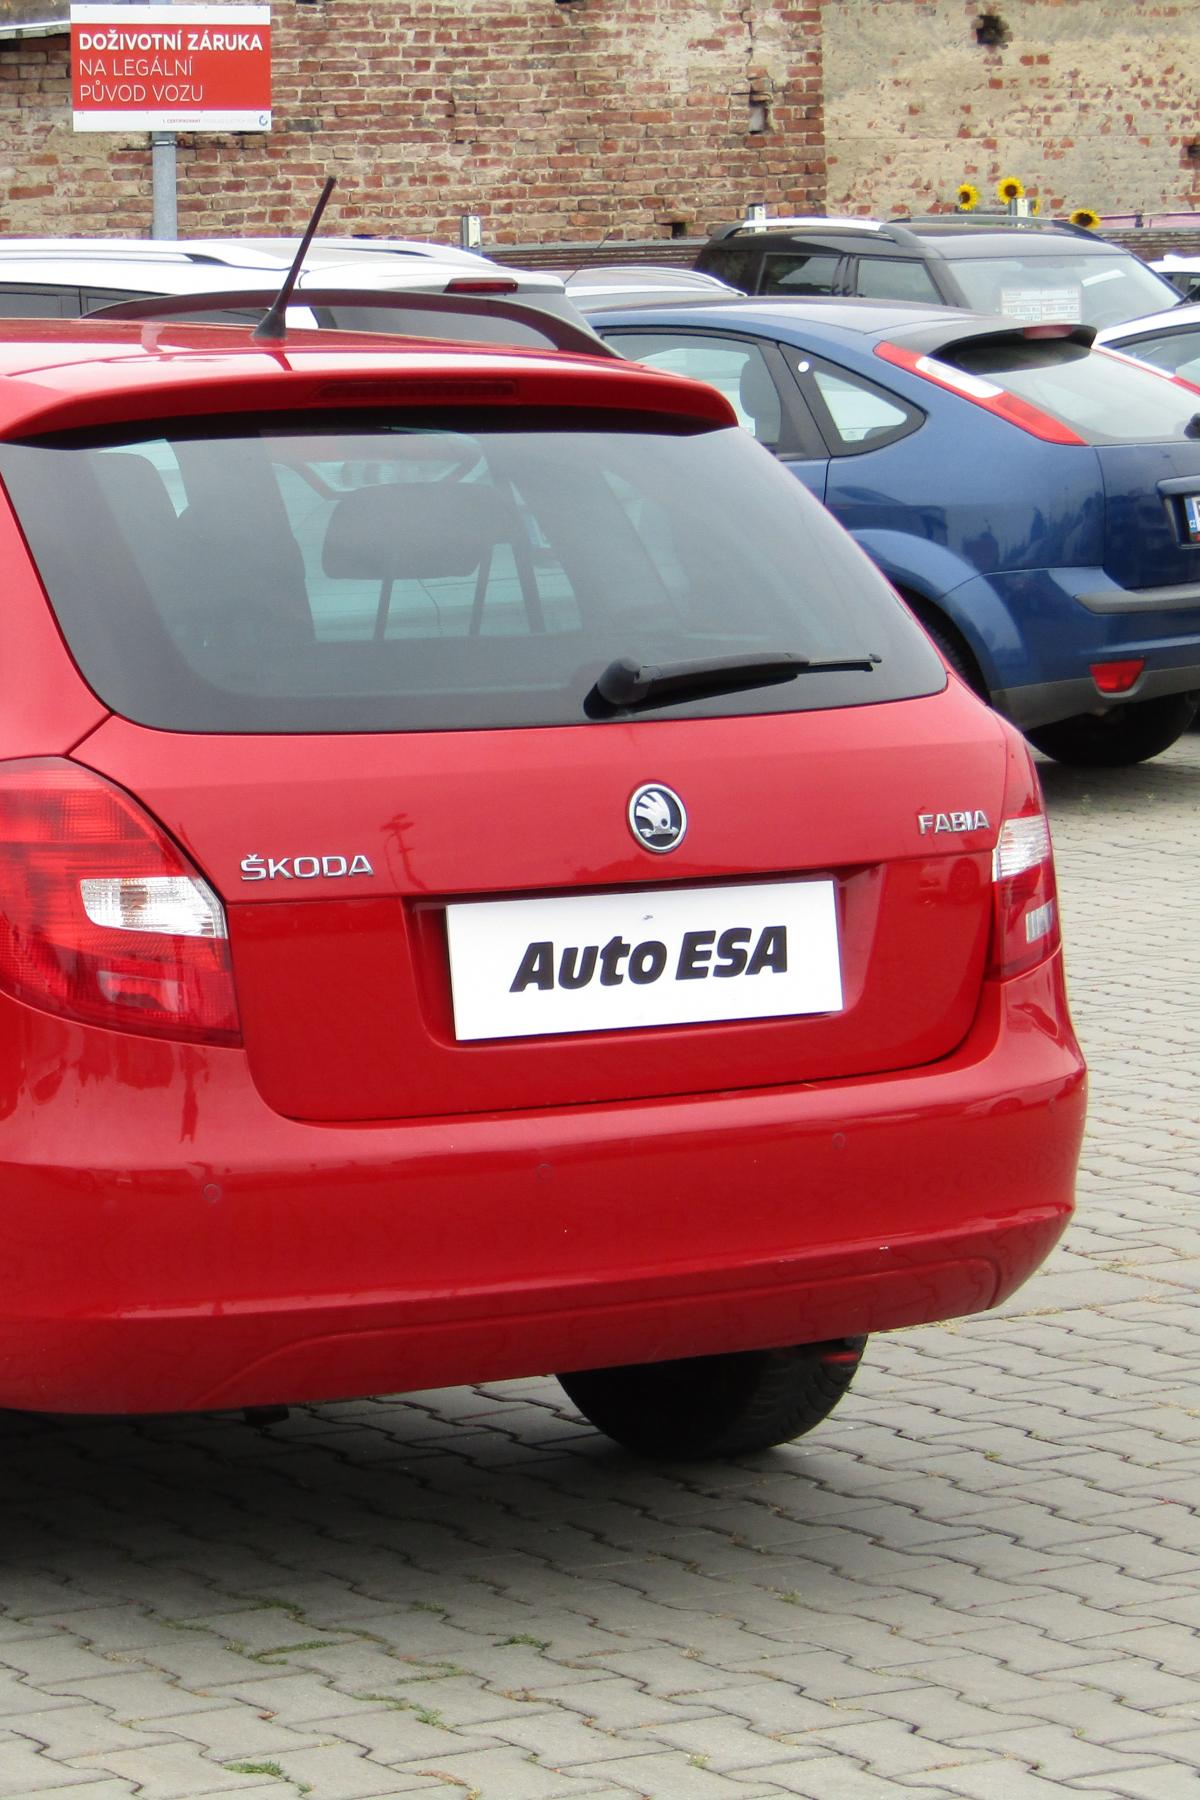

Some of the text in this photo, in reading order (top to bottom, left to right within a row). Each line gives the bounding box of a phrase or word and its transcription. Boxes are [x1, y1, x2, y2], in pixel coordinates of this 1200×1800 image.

[79, 29, 263, 51] DOŽIVOTNÍ ZÁRUKA
[79, 56, 193, 76] NA LEGÁLNÍ
[80, 79, 203, 102] PŮVOD VOZU
[917, 809, 990, 835] FABIA
[240, 854, 375, 881] ŠKODA
[509, 925, 788, 993] Auto ESA
